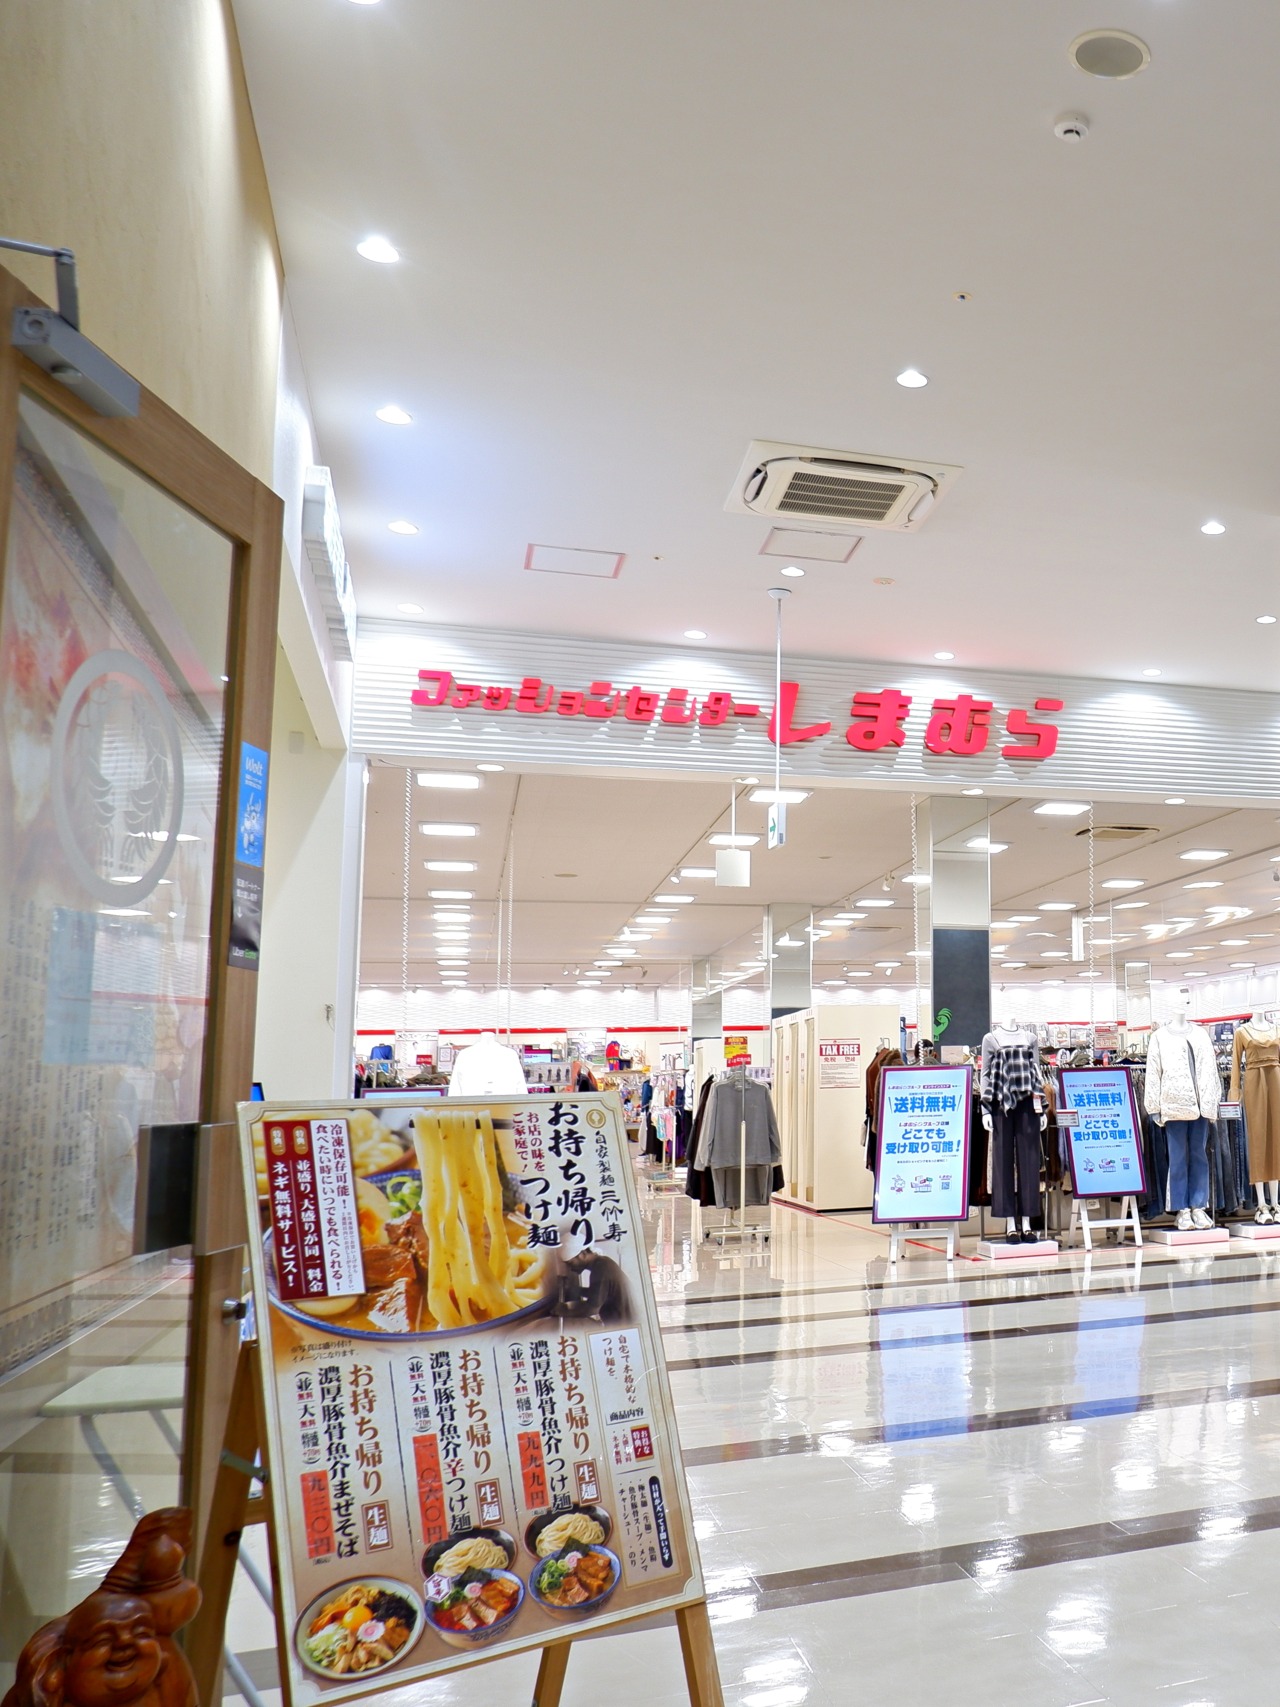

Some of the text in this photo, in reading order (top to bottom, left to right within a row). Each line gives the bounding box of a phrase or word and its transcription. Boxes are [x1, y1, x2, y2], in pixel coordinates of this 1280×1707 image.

[246, 756, 263, 776] Wolt
[821, 1045, 860, 1056] TAX FREE
[893, 1094, 957, 1113] 送料無料
[1073, 1091, 1123, 1108] 送料無料
[527, 1112, 545, 1172] お店の味を
[901, 1128, 947, 1140] どこでも
[1084, 1119, 1120, 1130] どこでも
[547, 1101, 597, 1246] お持ち帰り
[519, 1176, 563, 1249] つけ麺
[411, 1382, 426, 1397] 大
[513, 1372, 528, 1387] 大
[298, 1404, 315, 1420] 大
[529, 1340, 573, 1514] 濃厚豚骨魚介つけ麺
[557, 1335, 598, 1502] お持ち帰り 生麺
[609, 1407, 645, 1423] 商品内容
[348, 1364, 390, 1548] お持ち帰り 生麺
[429, 1350, 473, 1534] 濃厚豚骨魚介辛つけ麺
[458, 1349, 501, 1523] お持ち帰り 生麺
[318, 1366, 360, 1560] 濃厚豚骨魚介まぜそば
[526, 1436, 545, 1507] 九九九円
